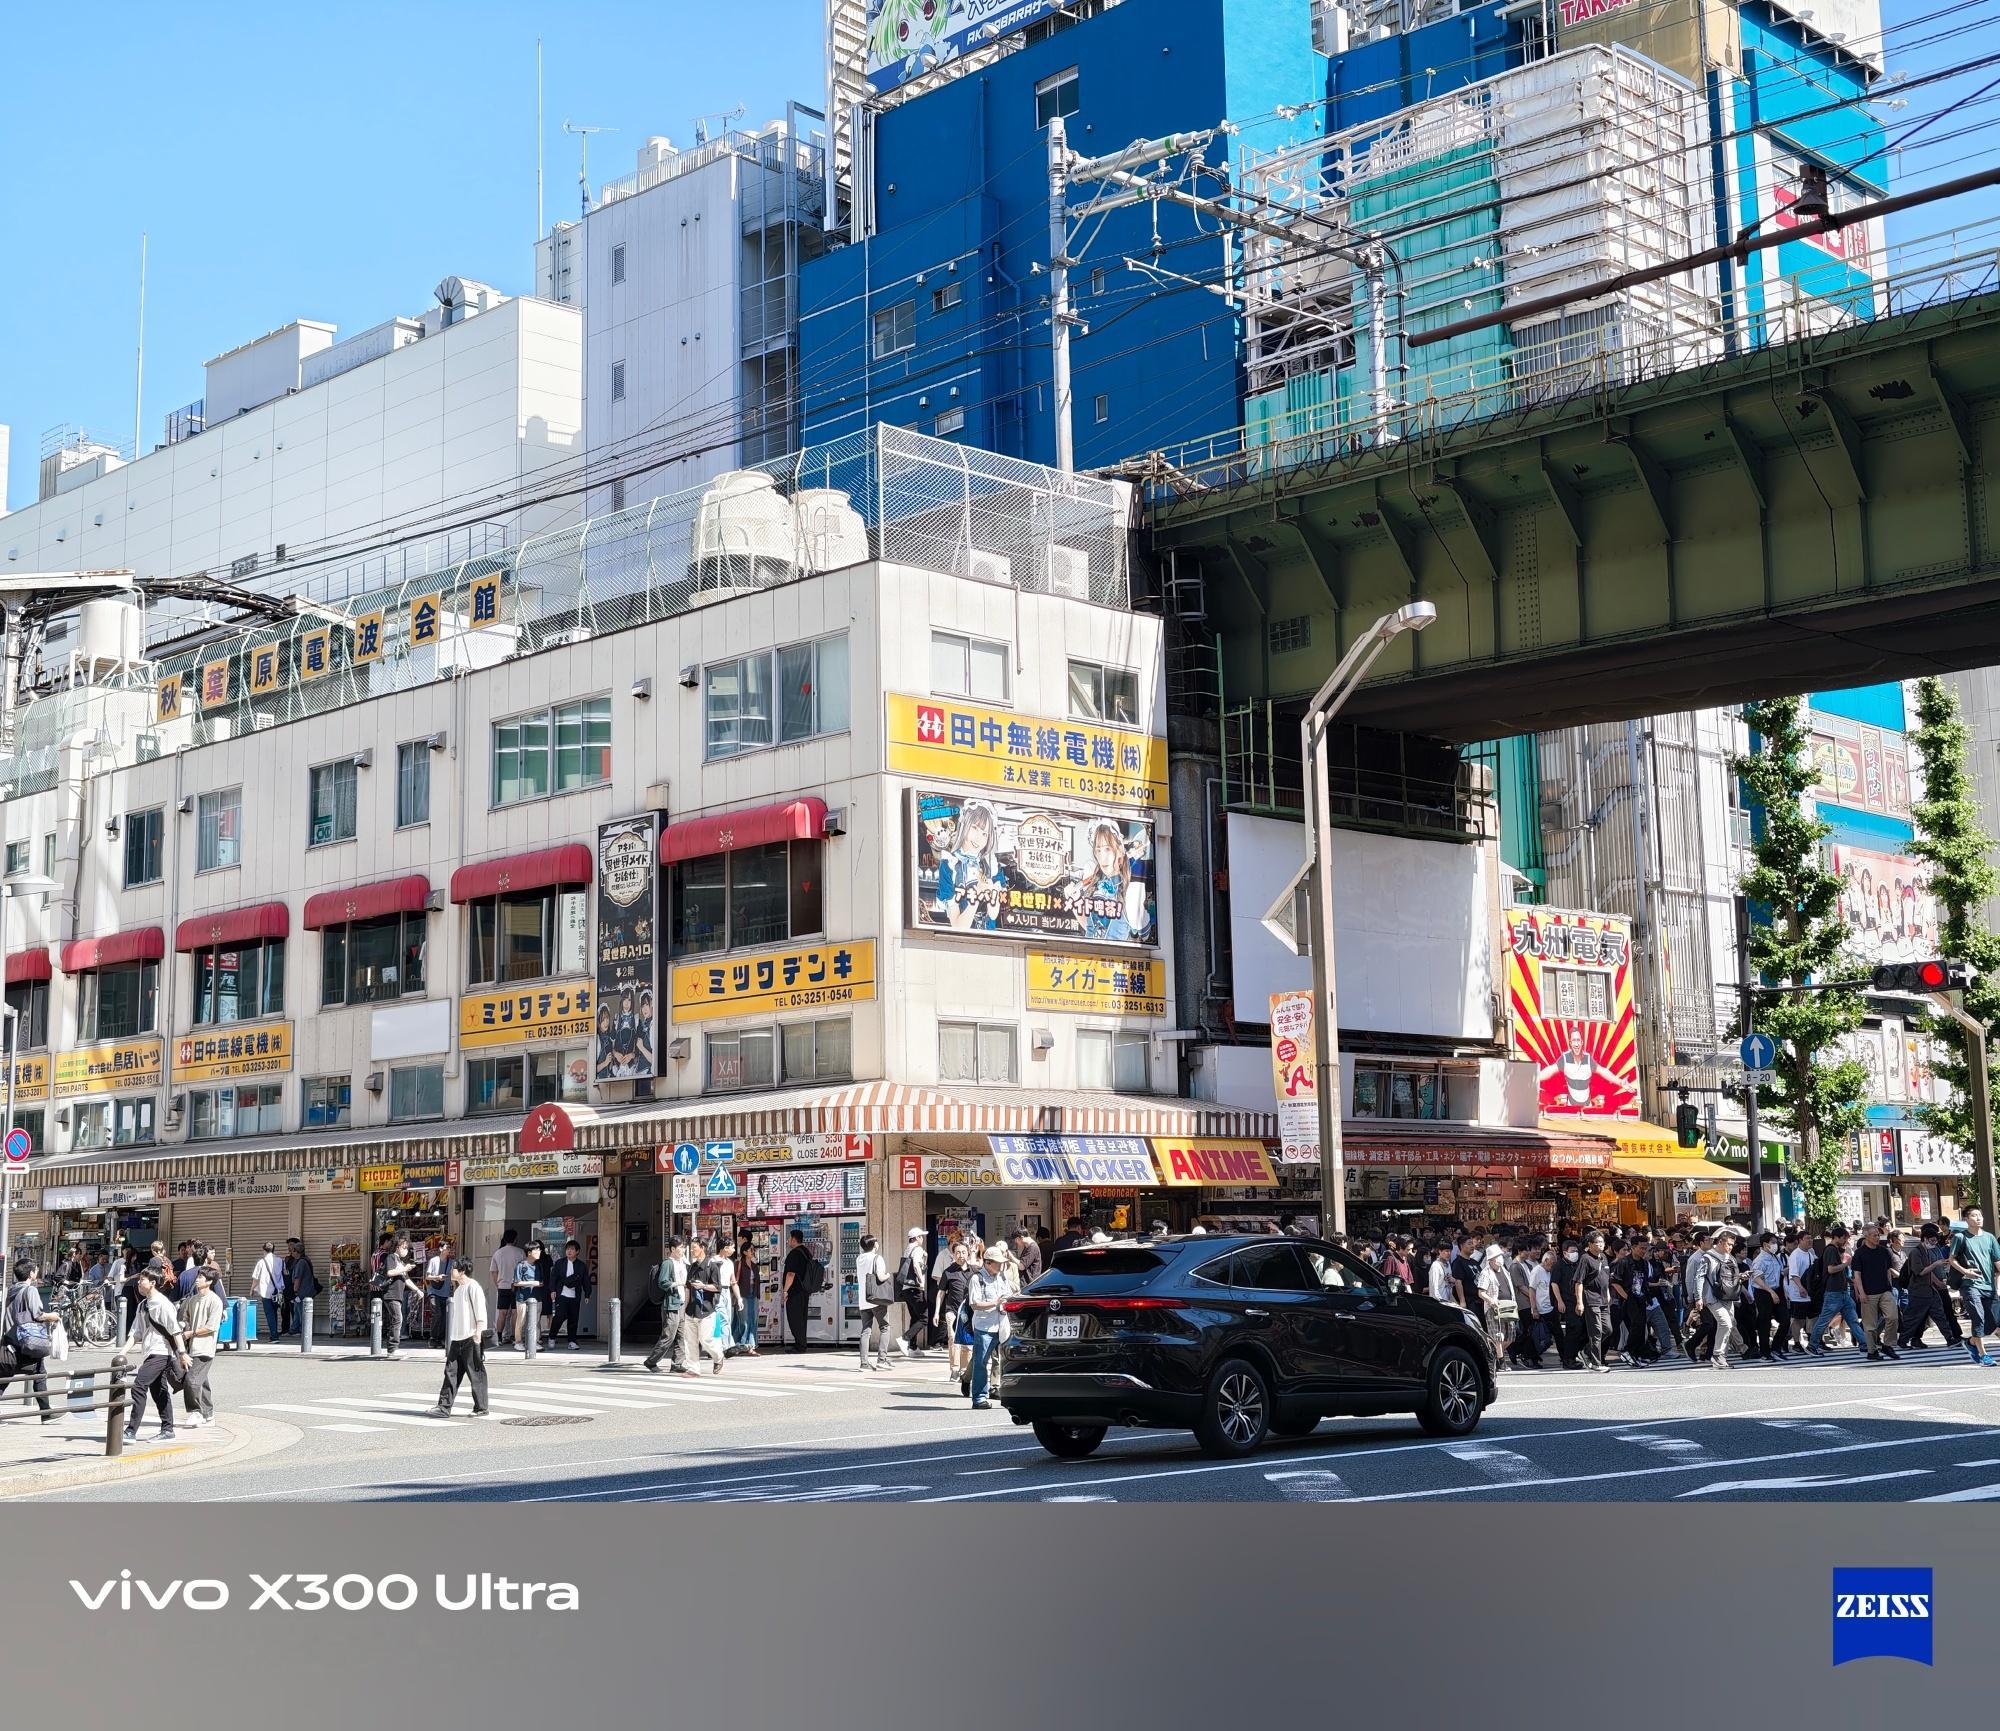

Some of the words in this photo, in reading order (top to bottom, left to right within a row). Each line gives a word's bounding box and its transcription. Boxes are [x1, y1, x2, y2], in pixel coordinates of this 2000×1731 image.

[160, 582, 496, 716] 秋葉原電波会館
[951, 712, 1141, 773] 田中無線電機(株)
[1003, 765, 1051, 788] 法人営業
[1058, 776, 1075, 789] TEL
[1514, 921, 1625, 965] 九州電気
[709, 950, 852, 994] ミツワデンキ
[1050, 967, 1146, 994] タイガー無線
[483, 989, 590, 1025] ミツワデンキ
[774, 997, 788, 1007] TEL
[525, 1030, 536, 1039] TEL
[194, 1033, 282, 1062] 田中無線電機(株)
[70, 1083, 89, 1093] PARTS
[115, 1079, 123, 1087] TEL
[733, 1146, 793, 1164] OCKER
[797, 1149, 818, 1159] CLOSE
[820, 1146, 843, 1158] 24:00
[463, 1166, 499, 1182] COIN
[501, 1161, 559, 1179] LOCKER
[562, 1166, 581, 1175] CLOSE
[1004, 1157, 1063, 1182] COIN
[1066, 1157, 1151, 1182] LOCKER
[1170, 1149, 1270, 1181] ANIME
[363, 1170, 400, 1182] FIGURE
[772, 1173, 838, 1193] メイドカジノ
[925, 1169, 970, 1186] COIN
[169, 1178, 236, 1197] 田中無線電機(株)
[1053, 1326, 1078, 1337] 58-99
